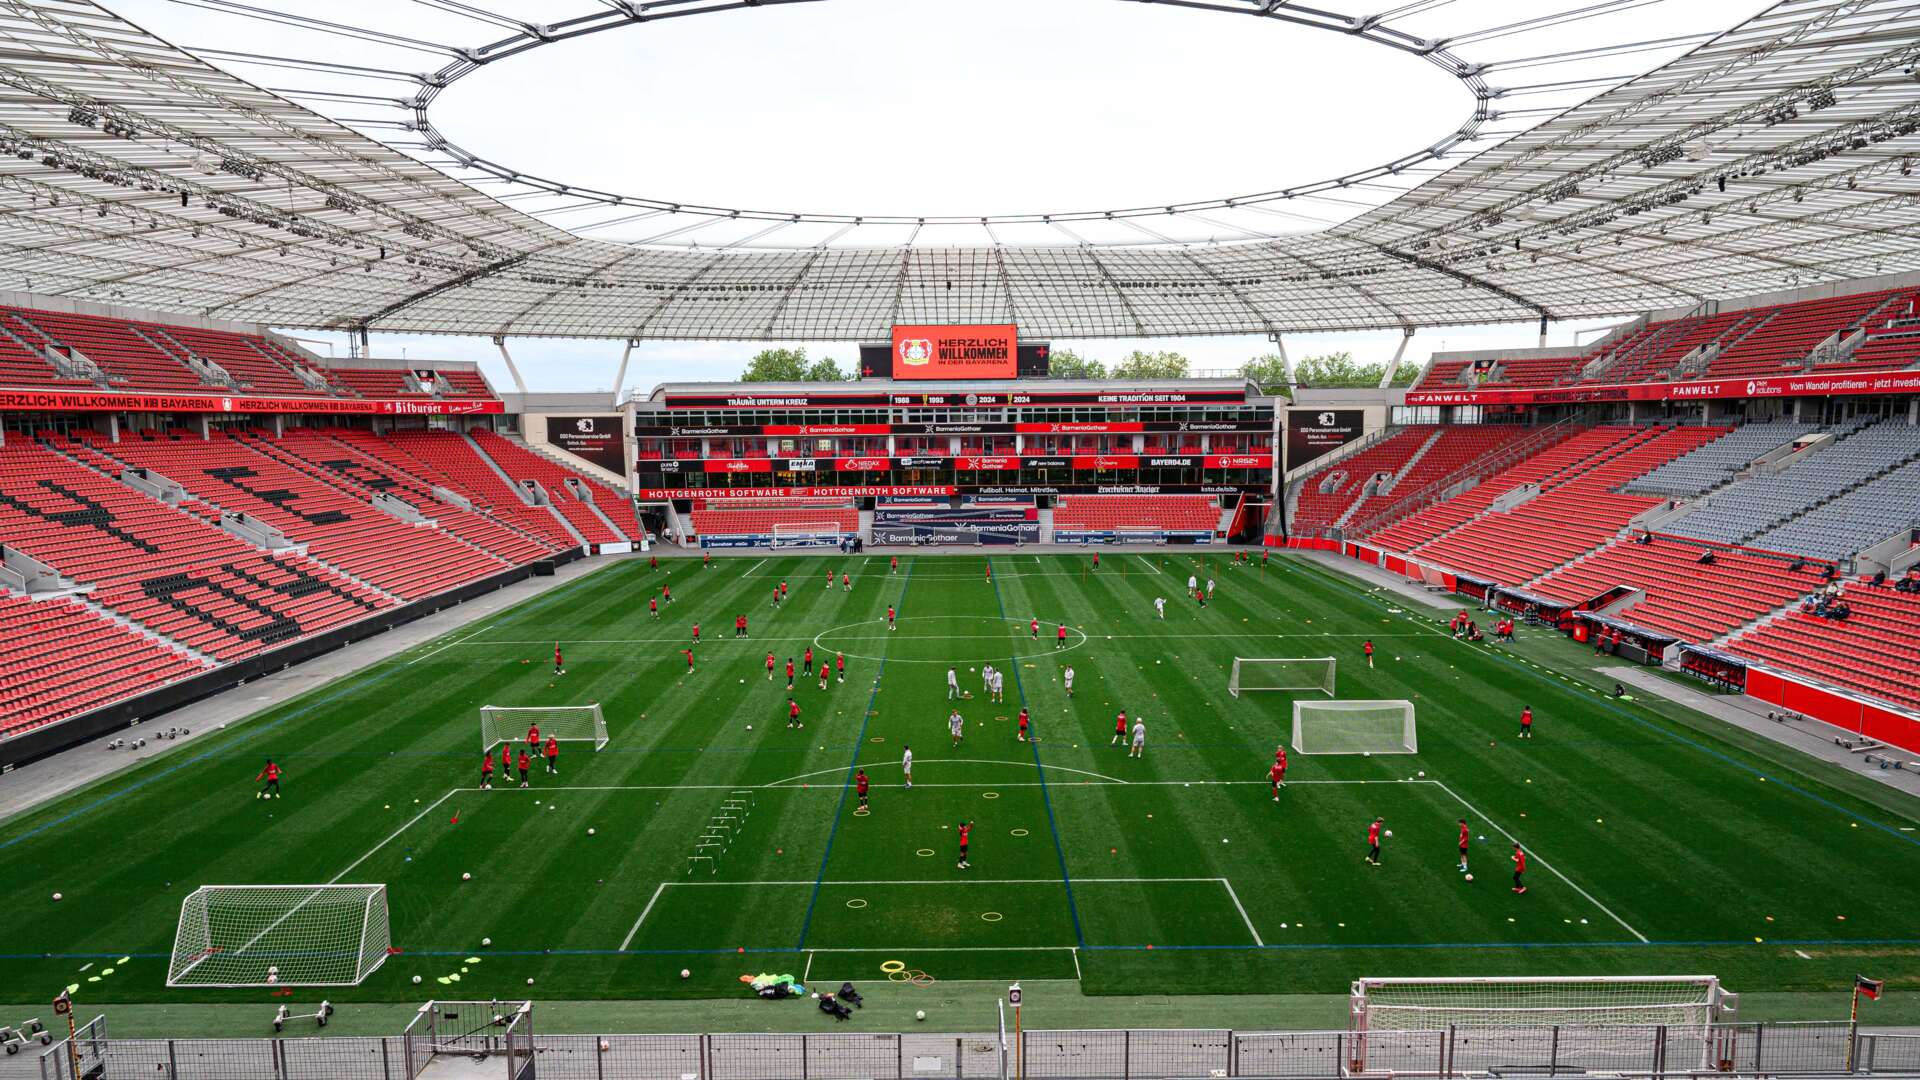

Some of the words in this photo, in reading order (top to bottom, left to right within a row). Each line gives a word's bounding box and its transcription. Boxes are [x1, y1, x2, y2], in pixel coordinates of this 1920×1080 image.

[938, 338, 1008, 346] HERZLICH
[938, 348, 1008, 359] WILLKOMMEN
[1673, 386, 1720, 395] FANWELT
[1790, 382, 1804, 390] Vom
[1805, 381, 1830, 390] Wandel
[1832, 380, 1867, 391] profitieren
[1874, 379, 1890, 391] jetzt
[59, 396, 141, 408] WILLKOMMEN
[161, 398, 214, 408] BAYARENA
[240, 401, 280, 410] HERZLICH
[281, 402, 328, 410] WILLKOMMEN
[395, 402, 442, 413] Bitburger
